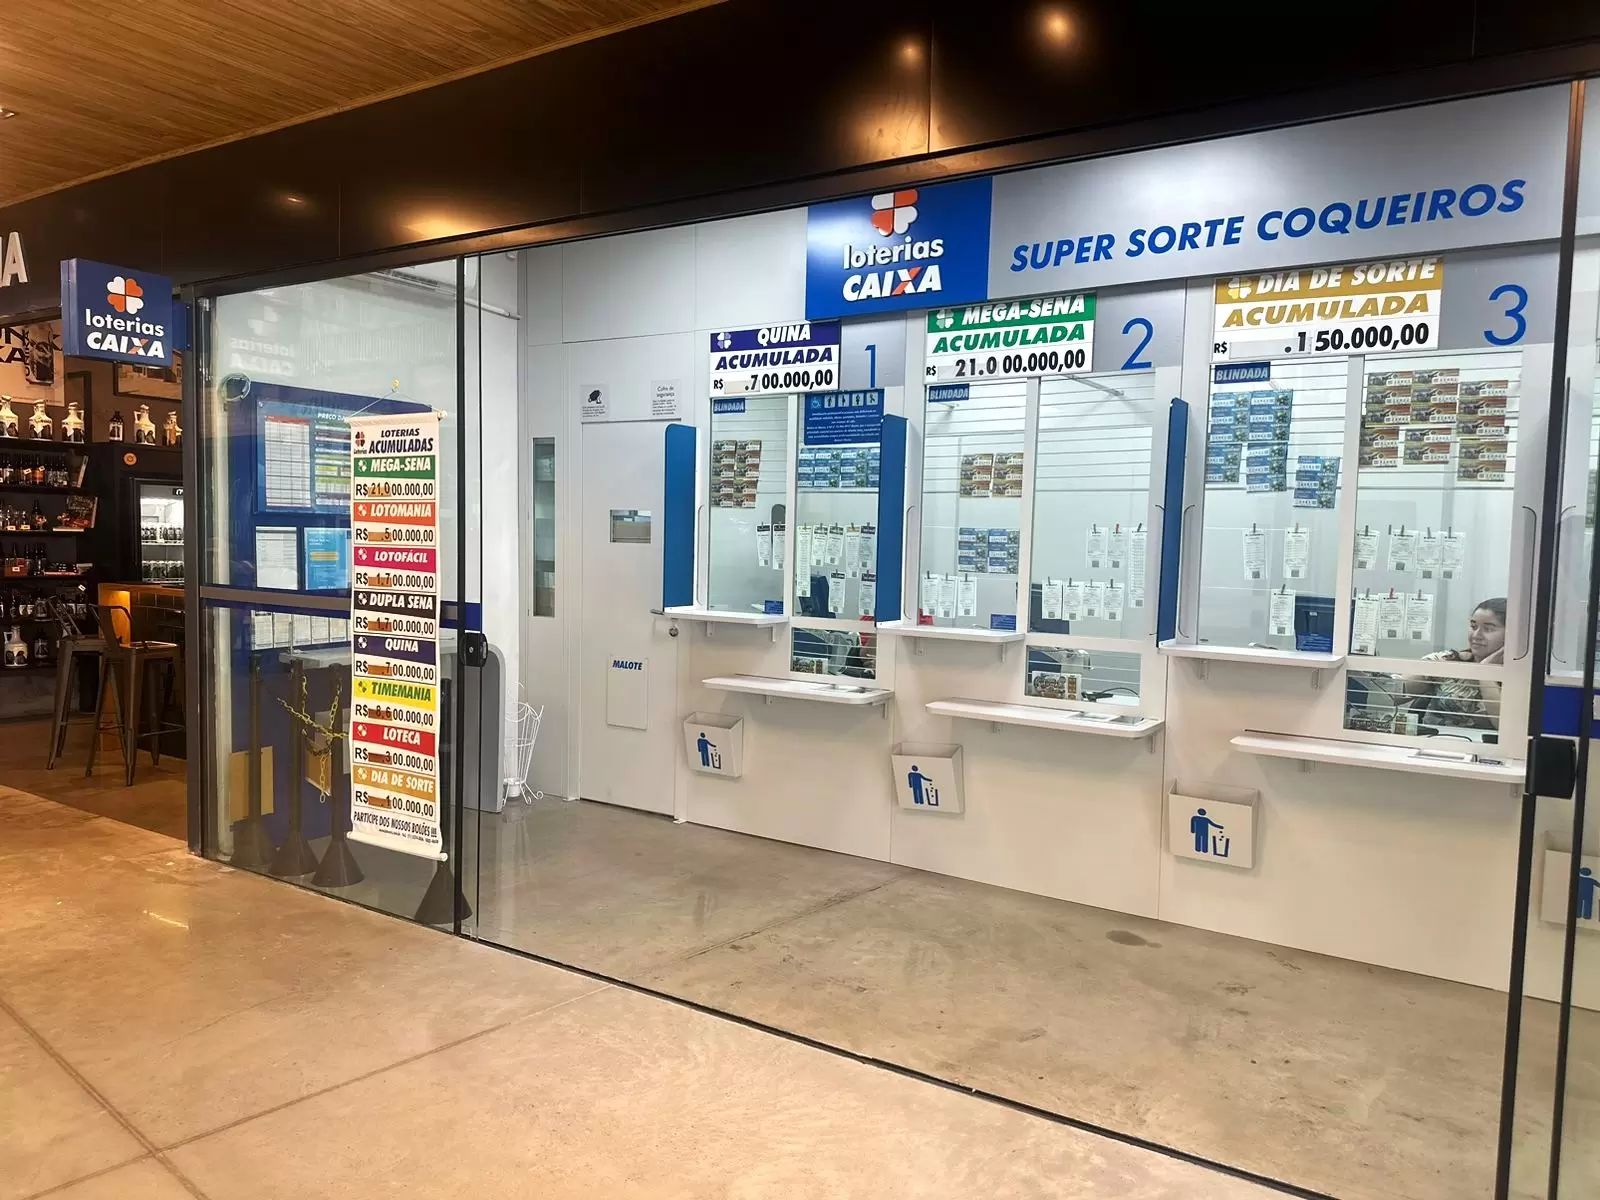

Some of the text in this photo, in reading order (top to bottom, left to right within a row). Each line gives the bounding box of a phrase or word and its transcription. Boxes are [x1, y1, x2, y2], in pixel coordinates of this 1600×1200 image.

[1010, 179, 1526, 272] SUPER SORTE COQUEIROS
[0, 231, 28, 287] A
[844, 236, 944, 270] loterias
[842, 264, 942, 302] CAIXA
[1256, 258, 1436, 295] DIA DE SORTE
[962, 294, 1085, 326] MEGA-SENA
[1222, 293, 1428, 328] ACUMULADA
[1484, 284, 1528, 346] 3
[85, 308, 164, 337] loterias
[757, 324, 810, 346] QUINA
[932, 324, 1085, 354] ACUMULADA
[86, 332, 165, 359] CAIXA
[1120, 317, 1154, 370] 2
[1214, 341, 1228, 354] R$
[715, 348, 832, 370] ACUMULADA
[864, 344, 876, 388] 1
[926, 366, 936, 376] R$
[1216, 367, 1268, 381] BLINDADA
[714, 378, 724, 390] R$
[929, 387, 969, 400] BLINDADA
[380, 428, 420, 438] LOTERIAS
[368, 438, 434, 454] ACUMULADAS
[370, 457, 431, 472] MEGA-SENA
[356, 484, 368, 496] R$
[370, 504, 432, 517] LOTOMANIA
[356, 528, 368, 540] R$
[374, 550, 428, 563] LOTOFÁCIL
[356, 572, 368, 586] R$
[369, 593, 433, 610] DUPLA SENA
[356, 616, 368, 629] R$
[385, 638, 418, 652] QUINA
[356, 660, 368, 673] R$
[612, 660, 643, 670] MALOTE
[372, 682, 431, 702] TIMEMANIA
[355, 704, 368, 717] R$
[383, 727, 420, 746] LOTECA
[355, 748, 368, 760] R$
[371, 770, 434, 794] DIA DE SORTE
[356, 790, 368, 804] R$
[354, 811, 378, 826] PARTICIPE
[379, 816, 390, 828] DOS
